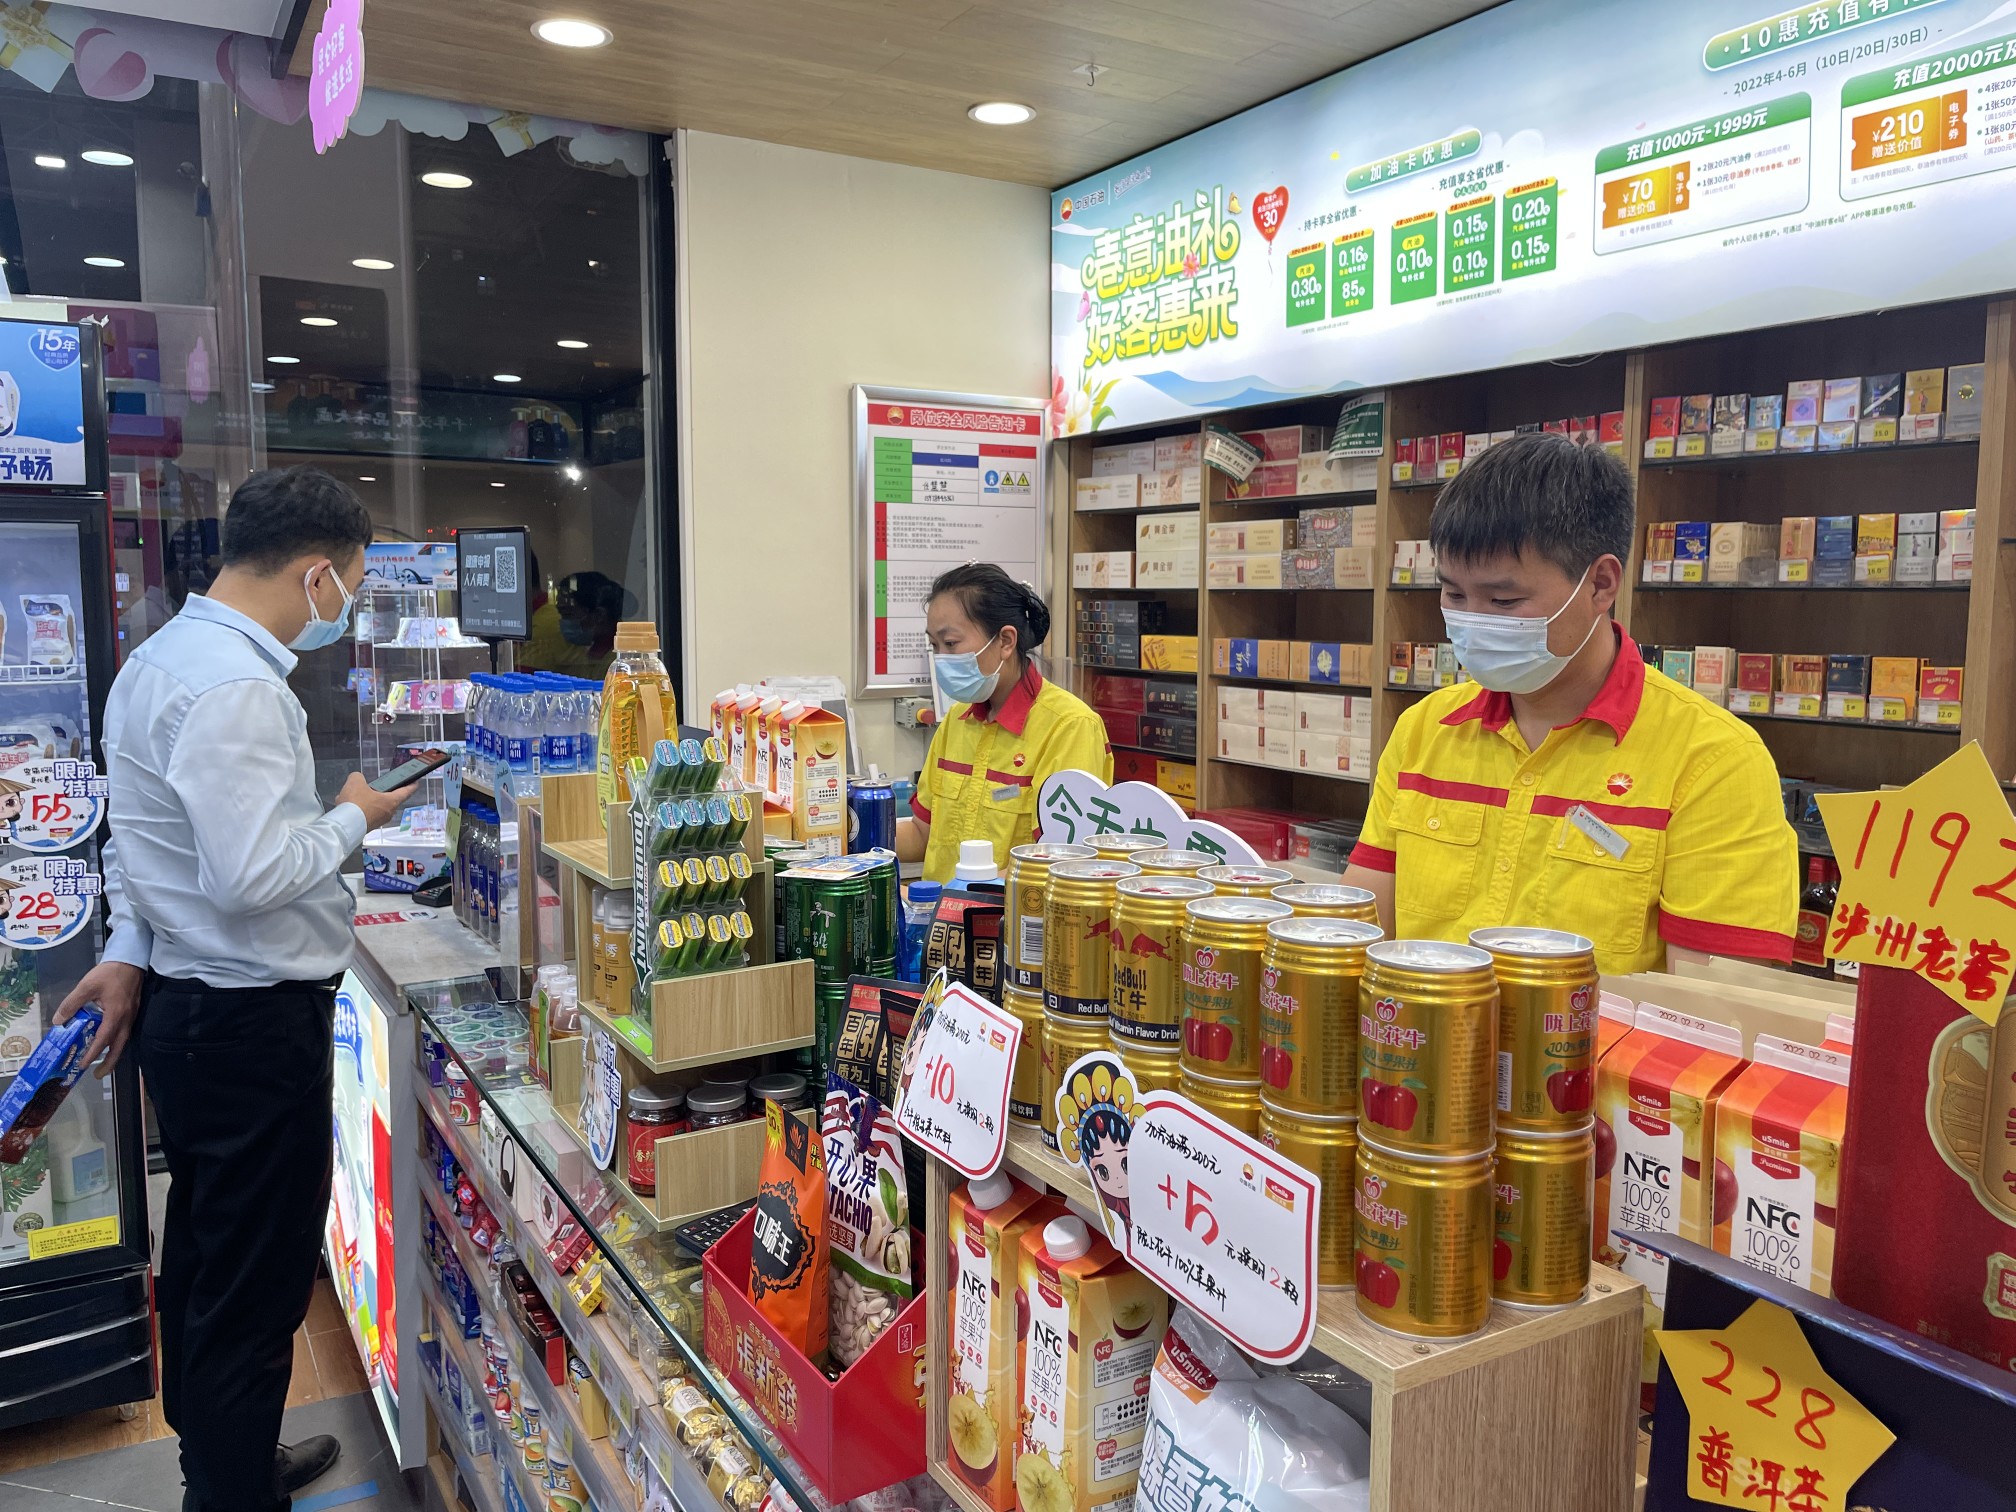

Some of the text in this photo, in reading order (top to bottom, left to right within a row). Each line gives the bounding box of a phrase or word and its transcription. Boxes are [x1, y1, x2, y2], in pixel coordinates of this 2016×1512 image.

[1740, 0, 1918, 54] 10惠充值有
[1626, 106, 1768, 162] 充值1000元-1999元
[1948, 102, 1959, 140] 电子券
[1370, 140, 1453, 182] 加油卡优惠
[1871, 136, 1922, 160] 赠送价值
[1439, 160, 1504, 191] 充值享全省优惠
[1675, 171, 1684, 205] 电子券
[1075, 189, 1105, 211] 中国石油
[1617, 200, 1656, 220] 赠送价值
[1304, 205, 1357, 231] 持卡享全省优惠
[1081, 185, 1240, 300] 春意油礼
[1406, 237, 1421, 248] 汽油
[1084, 263, 1239, 367] 好客惠来
[37, 329, 76, 352] 15年
[910, 409, 1027, 433] 岗位安全风险告知卡
[779, 756, 792, 770] NFC
[64, 779, 109, 797] 特惠
[32, 793, 72, 823] 55
[1046, 783, 1227, 865] 今天
[53, 877, 100, 896] 特惠
[633, 810, 649, 974] DOUBLEMINT
[16, 892, 60, 919] 28
[929, 924, 947, 965] 百年
[975, 942, 996, 984] 百年
[1113, 966, 1148, 991] RedBull
[1183, 963, 1239, 991] 陇上花牛
[1078, 1003, 1107, 1014] Red Bull
[1113, 986, 1148, 1011] 红牛
[837, 1013, 863, 1057] 百年
[1135, 1026, 1158, 1040] Flavor
[1360, 1014, 1426, 1050] 陇上花牛
[1659, 1009, 1705, 1031] 2022 02 22
[1783, 1043, 1837, 1065] 2022 02 22
[925, 1053, 955, 1105] +10
[1009, 1103, 1034, 1118] 味饮料
[1637, 1094, 1662, 1108] uSmile
[1635, 1115, 1664, 1131] Premium
[1761, 1134, 1790, 1149] uSmile
[827, 1136, 878, 1200] 开心果
[1623, 1151, 1671, 1190] NFC
[1759, 1158, 1792, 1175] Premium
[829, 1184, 873, 1236] TACHIO
[1157, 1173, 1219, 1247] +5
[1621, 1180, 1671, 1219] 100%
[1746, 1196, 1801, 1238] NFC
[754, 1207, 793, 1267] 口味王
[1744, 1227, 1800, 1270] 100%
[962, 1272, 987, 1304] NFC
[961, 1294, 987, 1330] 100%
[959, 1315, 985, 1349] 苹果汁
[1033, 1322, 1064, 1359] NFC
[1032, 1345, 1063, 1386] 100%
[1096, 1343, 1111, 1356] NFC
[1170, 1346, 1207, 1388] uSmile
[1031, 1369, 1061, 1405] 苹果汁
[1702, 1340, 1836, 1450] 228
